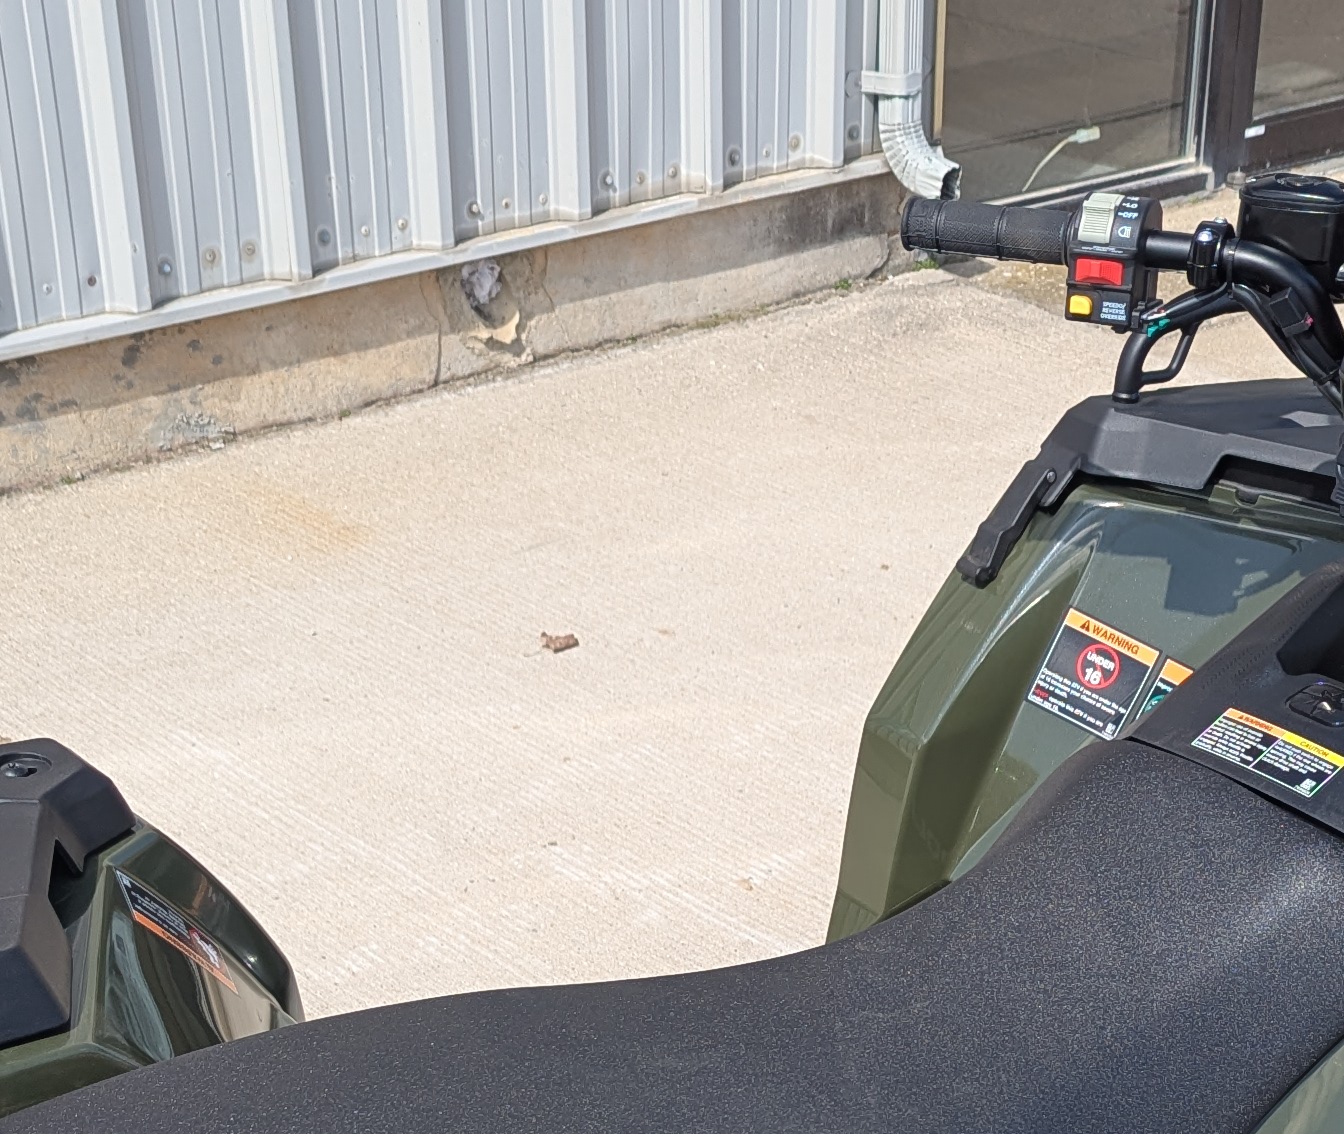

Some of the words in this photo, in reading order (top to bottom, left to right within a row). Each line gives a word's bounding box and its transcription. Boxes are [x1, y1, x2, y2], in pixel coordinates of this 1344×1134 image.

[1093, 626, 1139, 655] WARNING
[1086, 652, 1116, 671] UNDER
[1084, 667, 1102, 685] 16
[1300, 742, 1329, 757] CAUTION
